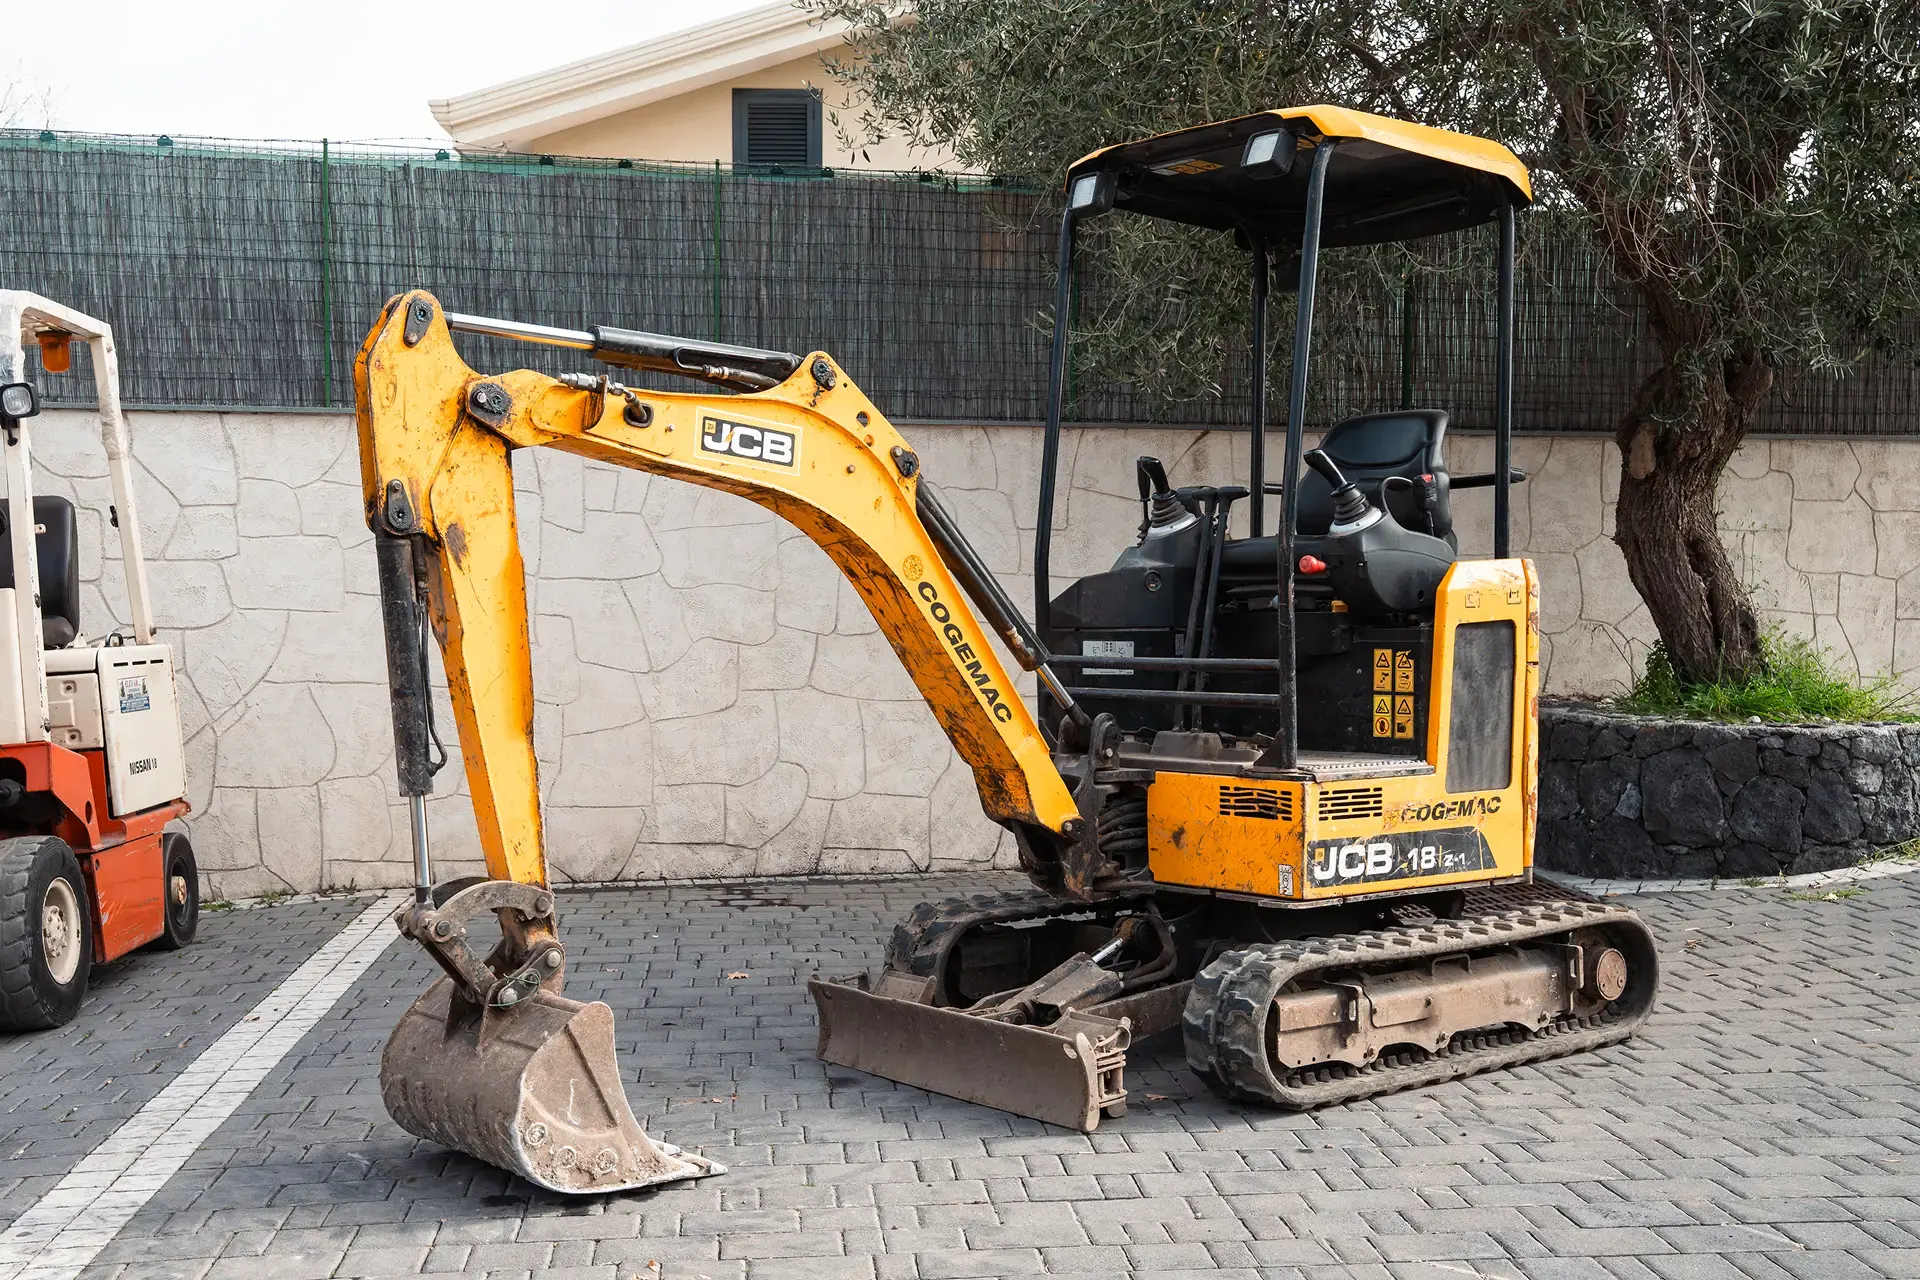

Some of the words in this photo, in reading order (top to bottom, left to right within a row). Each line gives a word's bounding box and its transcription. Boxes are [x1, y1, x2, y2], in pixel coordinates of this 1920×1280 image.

[703, 423, 793, 464] JCB
[918, 581, 1012, 723] COGEMAC
[129, 758, 151, 775] NISSAN
[1401, 797, 1501, 823] COGEMAC
[1313, 843, 1393, 880] JCB
[1407, 847, 1436, 870] 18
